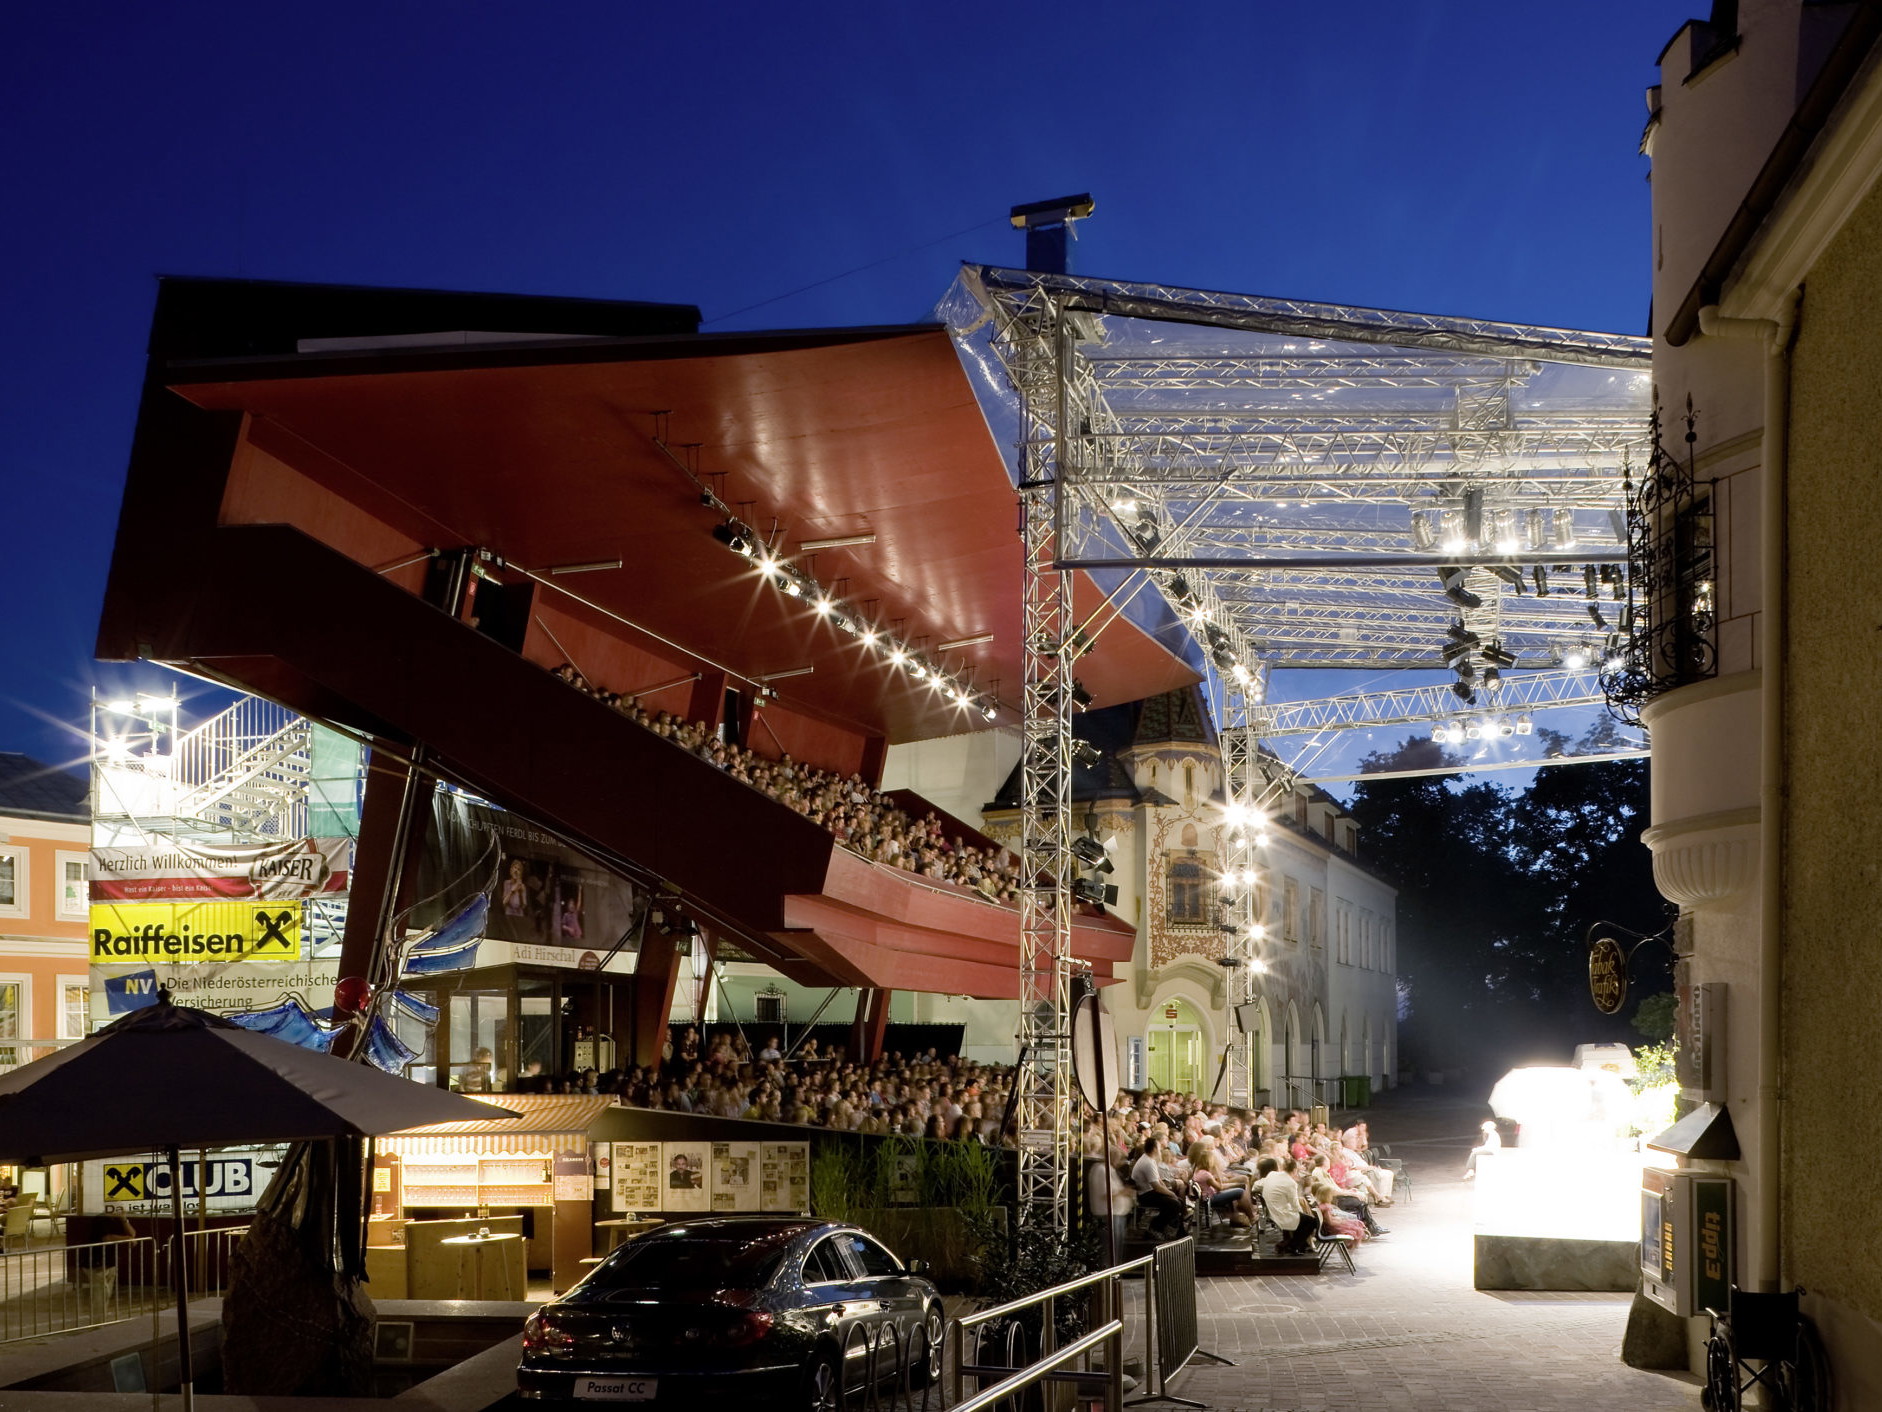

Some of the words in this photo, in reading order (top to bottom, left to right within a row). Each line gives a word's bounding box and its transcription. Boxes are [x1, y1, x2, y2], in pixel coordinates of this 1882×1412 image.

[528, 831, 539, 842] BIS
[99, 855, 147, 872] Herzlich
[152, 853, 238, 870] Willkommen!
[258, 858, 313, 880] KAISER
[94, 924, 244, 956] Raiffeisen
[513, 945, 532, 960] Adi
[535, 947, 576, 963] Hirschal
[125, 978, 153, 995] NV
[167, 977, 189, 989] Die
[193, 973, 338, 990] Niederösterreichische
[146, 1162, 250, 1197] CLUB
[105, 1204, 124, 1214] Da
[128, 1203, 145, 1212] ist
[1701, 1211, 1721, 1280] tipp3
[587, 1381, 625, 1393] Passat
[628, 1382, 646, 1394] CC
